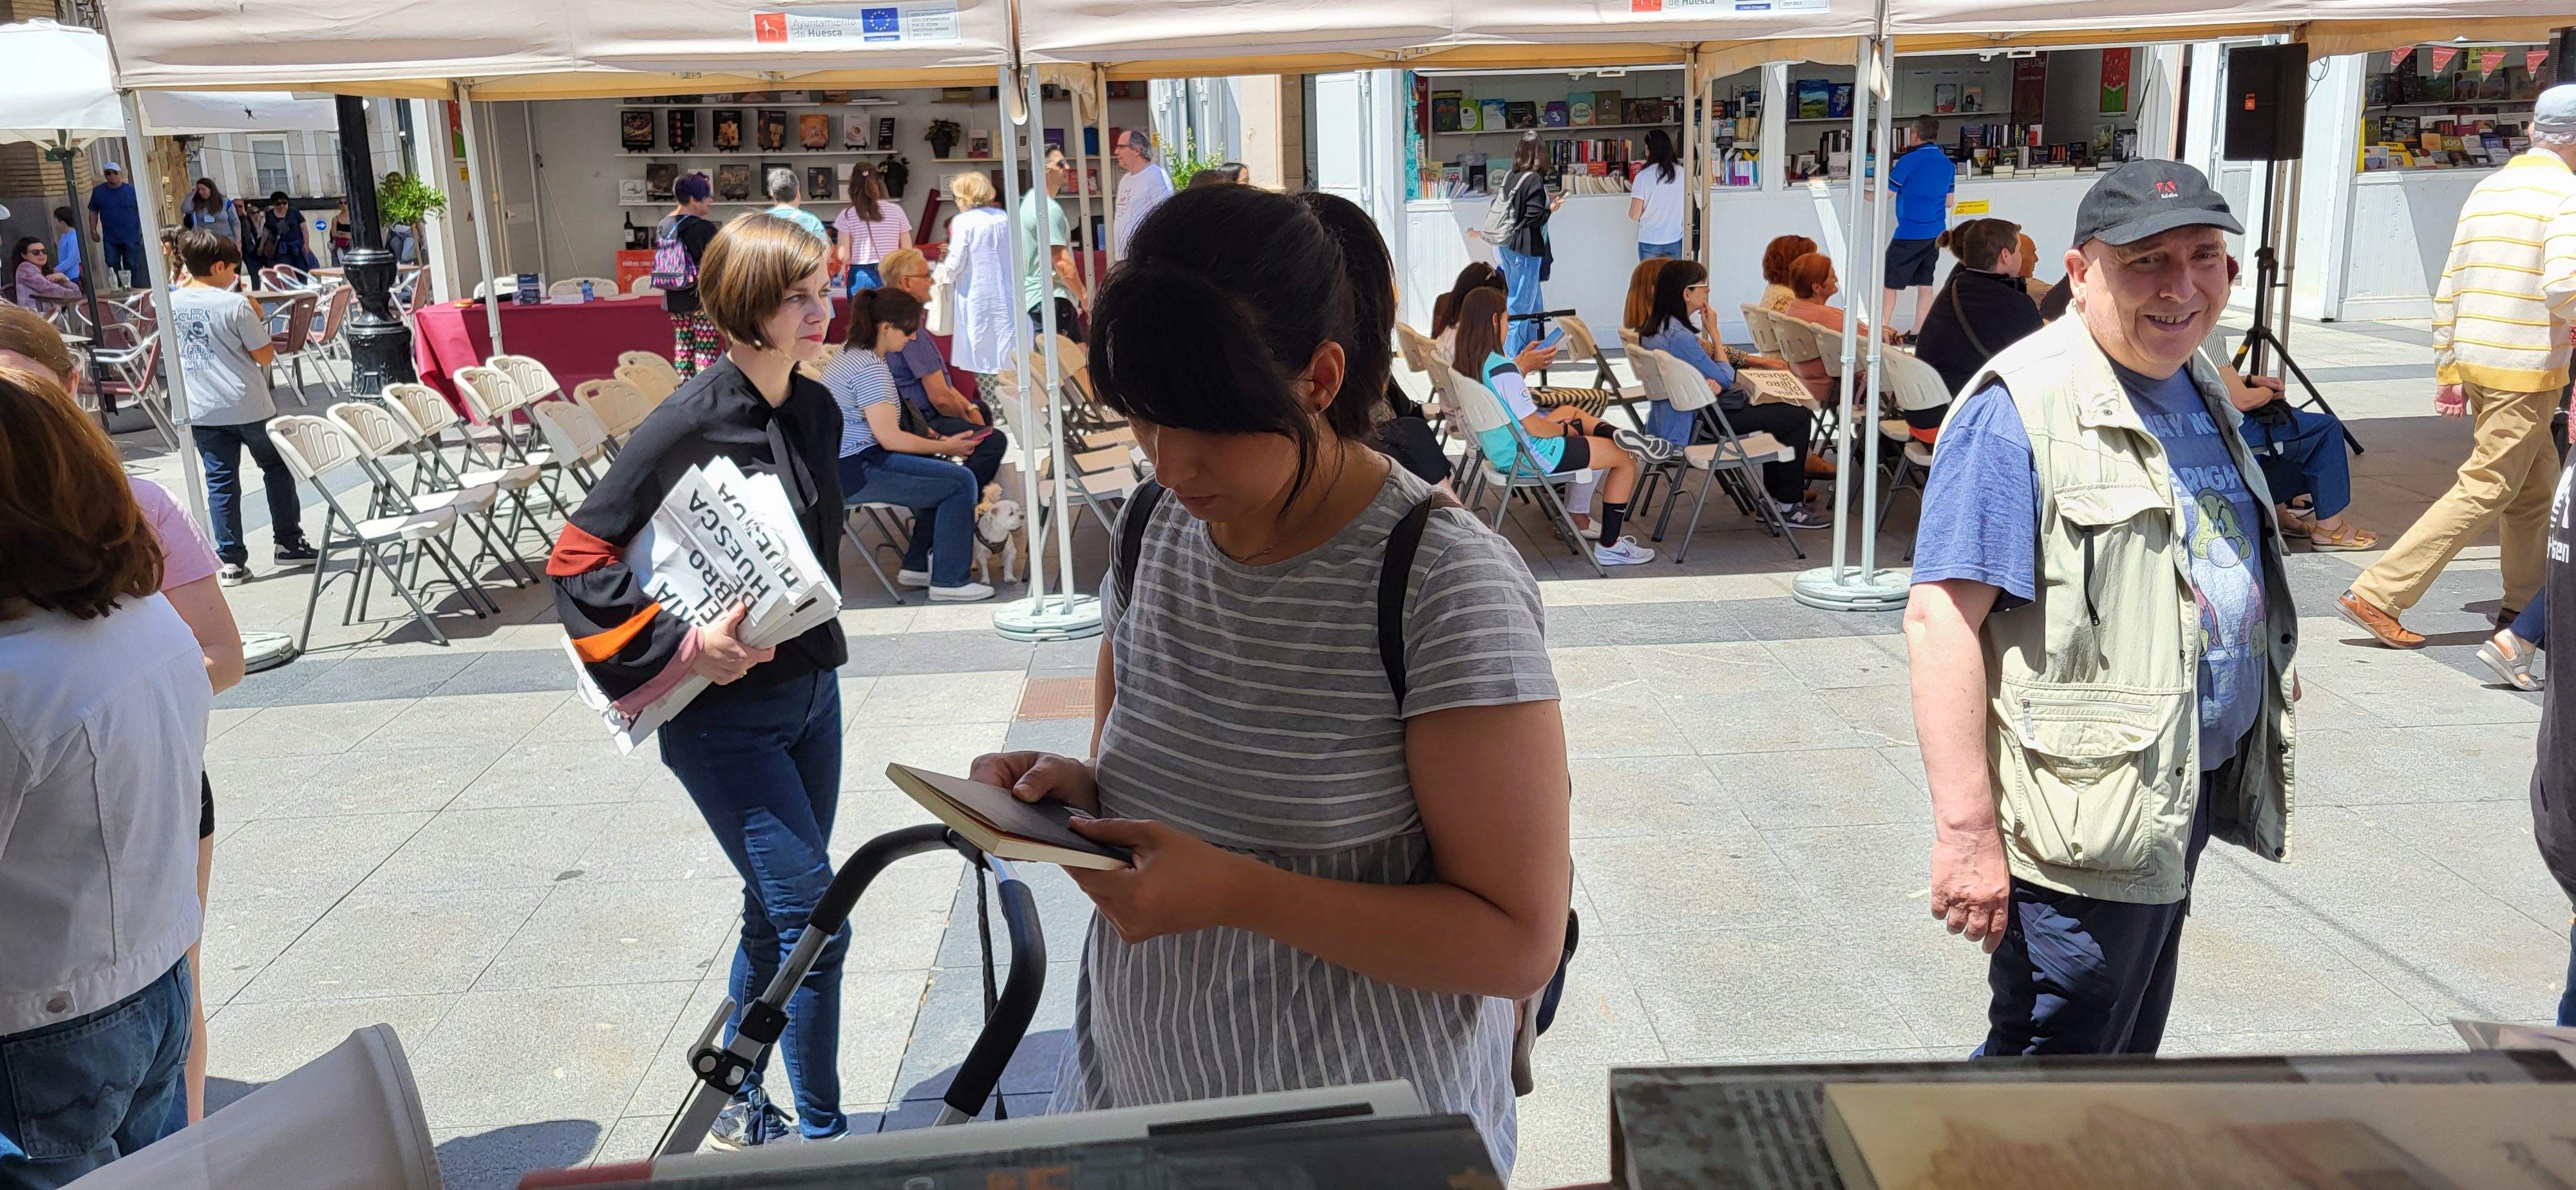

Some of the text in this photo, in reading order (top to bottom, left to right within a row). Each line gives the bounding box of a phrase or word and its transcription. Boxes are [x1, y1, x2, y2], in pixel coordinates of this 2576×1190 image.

[793, 18, 856, 30] Ayuntamiento
[808, 29, 842, 37] Huesca
[2187, 411, 2219, 435] NO
[2179, 463, 2242, 492] RIGH
[688, 488, 772, 599] HUESCA
[688, 549, 740, 613] IBRO
